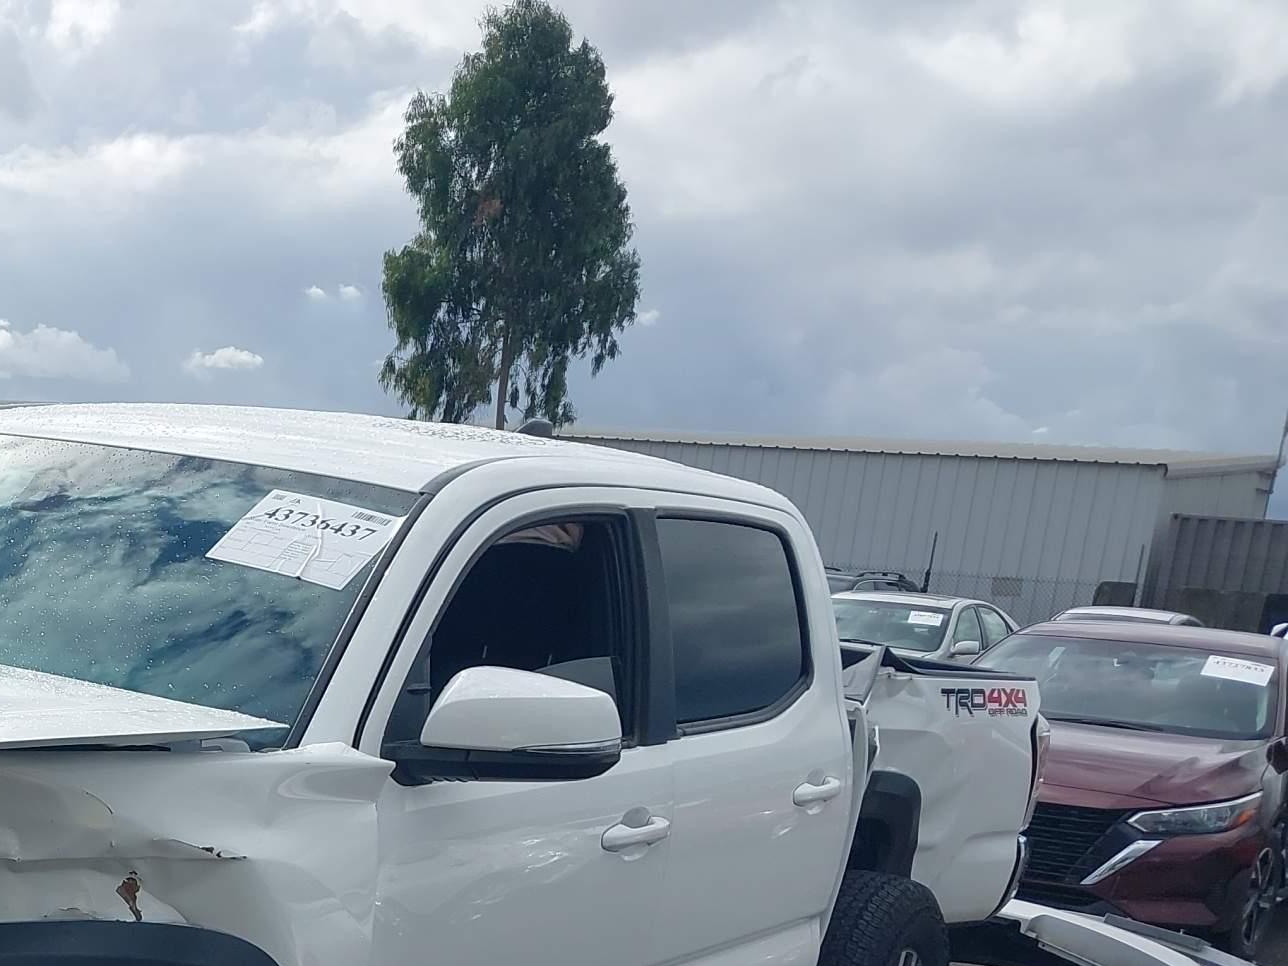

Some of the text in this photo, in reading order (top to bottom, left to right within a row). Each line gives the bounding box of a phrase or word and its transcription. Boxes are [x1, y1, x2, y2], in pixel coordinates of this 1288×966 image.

[264, 506, 378, 541] 43736437
[941, 688, 987, 717] TRD
[1006, 708, 1028, 717] ROAD
